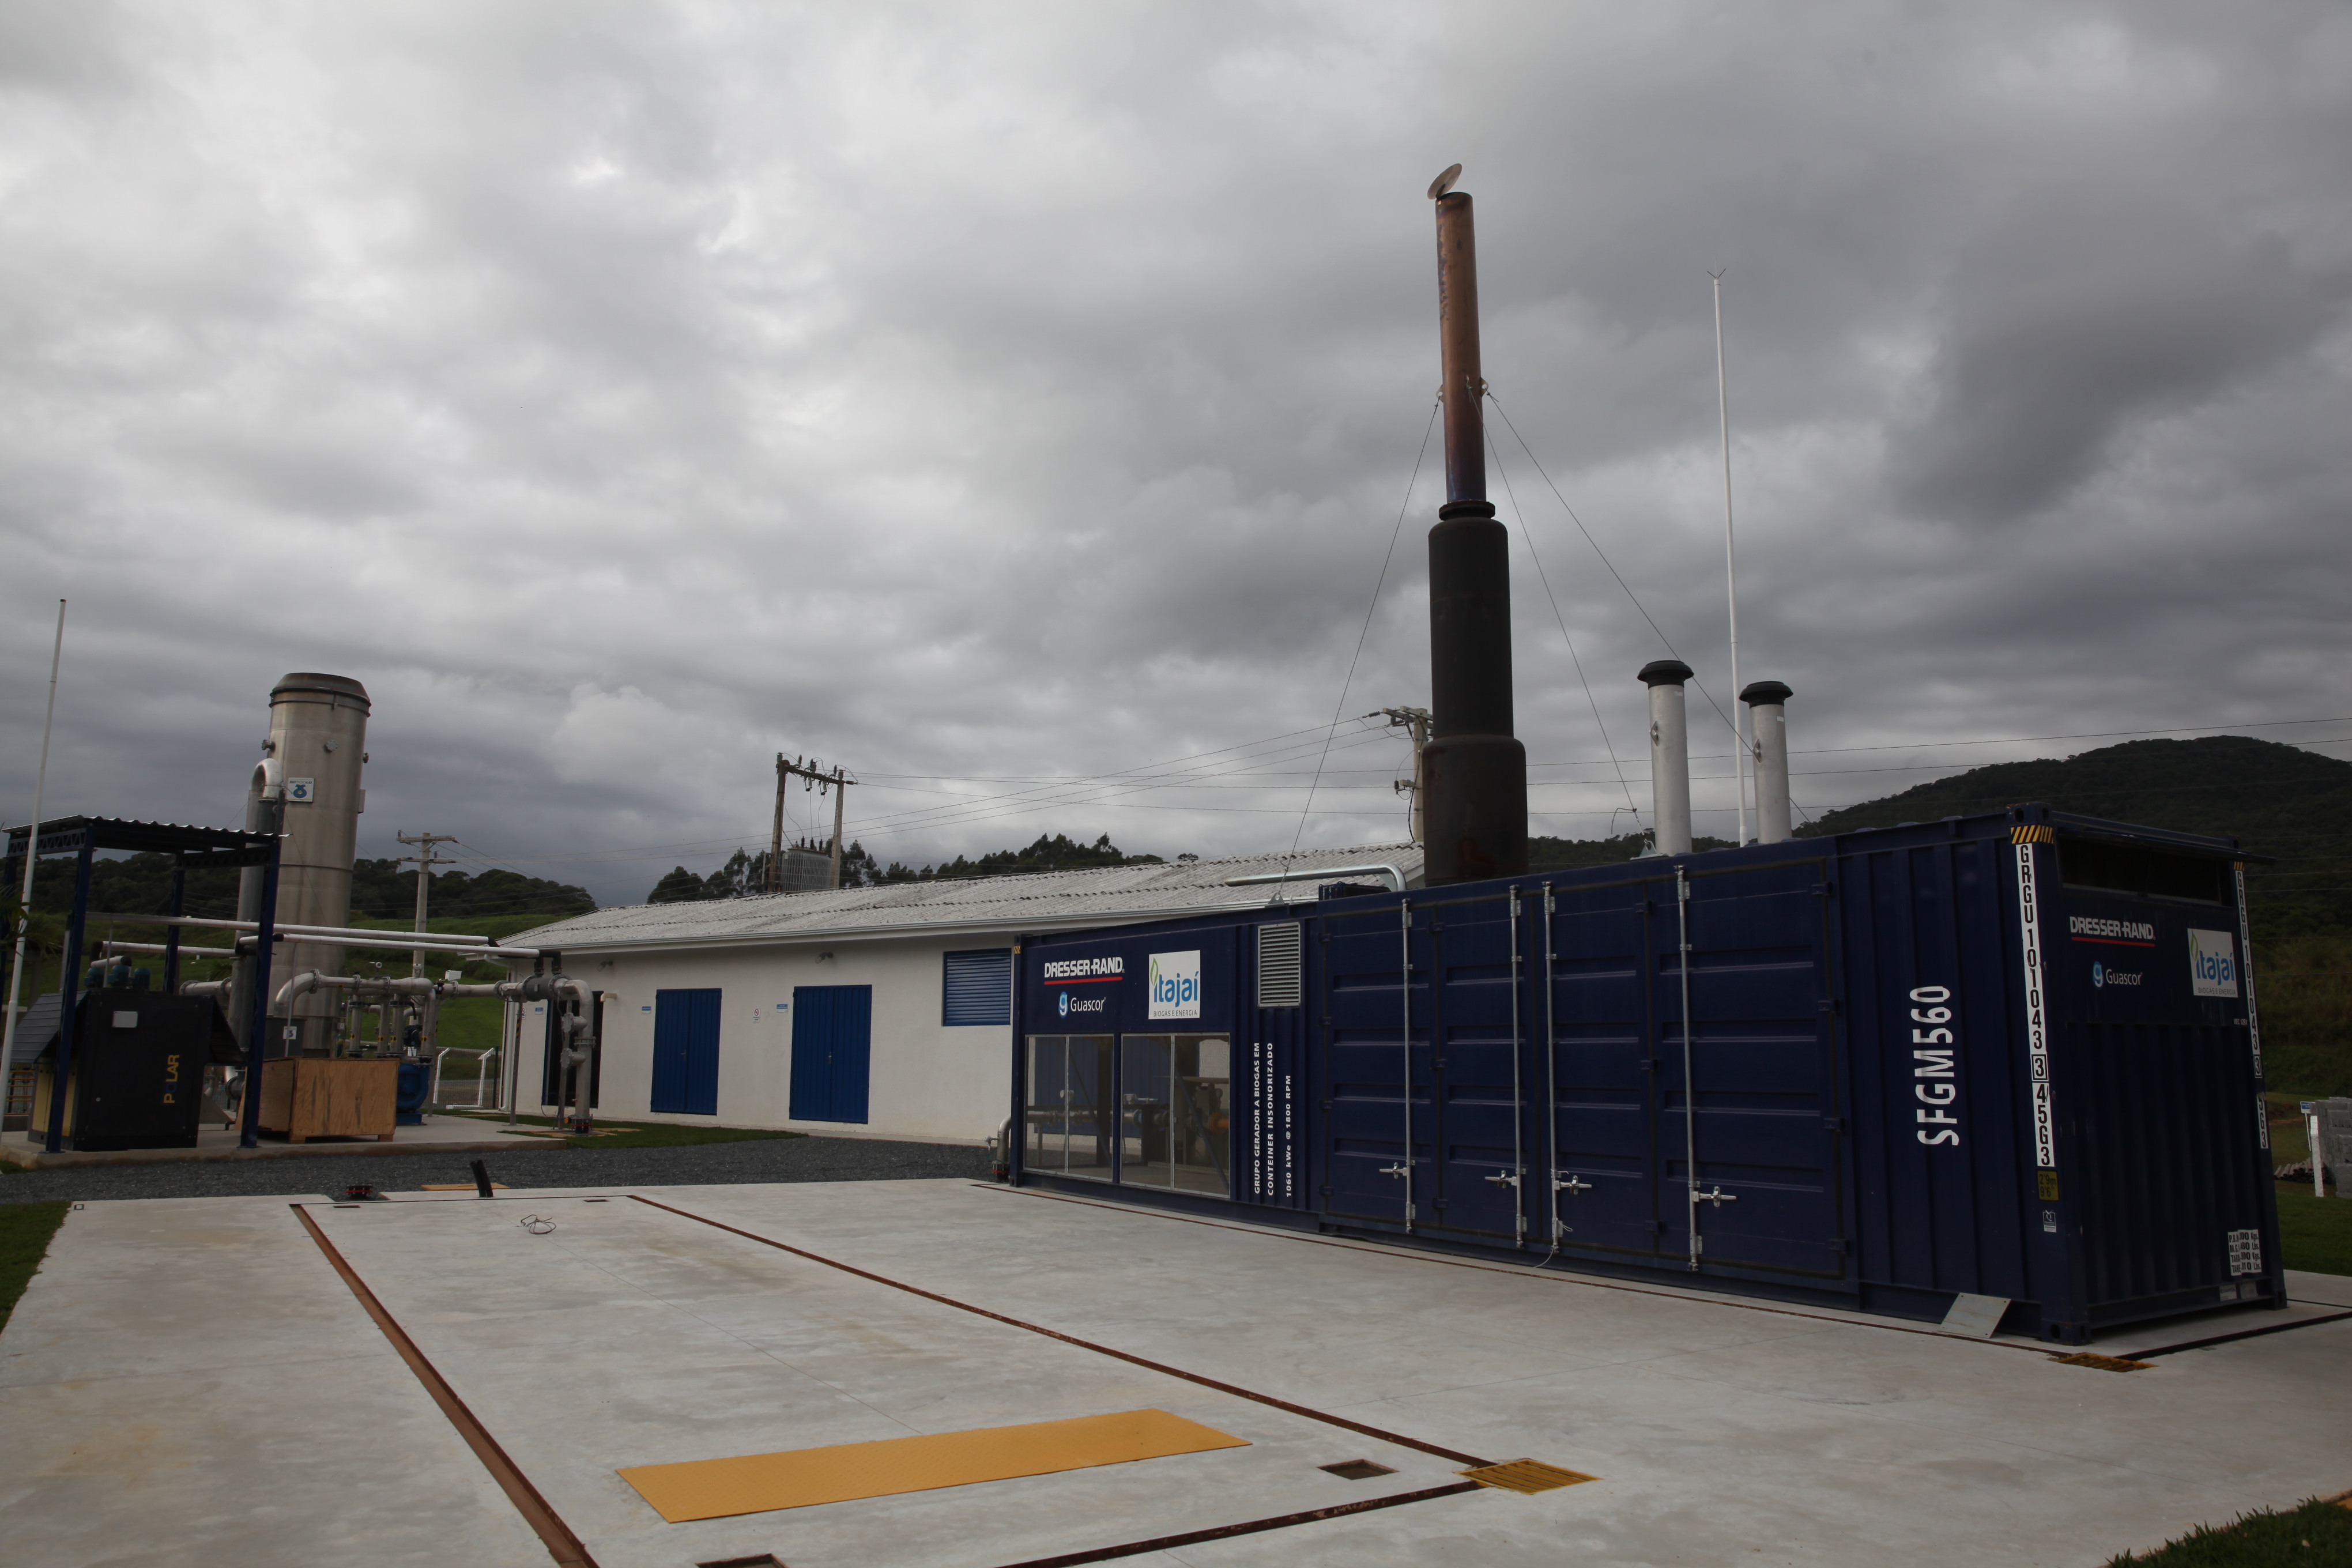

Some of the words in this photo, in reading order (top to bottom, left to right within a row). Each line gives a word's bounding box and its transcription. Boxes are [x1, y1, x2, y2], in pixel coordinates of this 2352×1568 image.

[2020, 845, 2034, 924] GRGU
[2237, 871, 2247, 940] GRGU
[2070, 916, 2154, 940] DRESSER-RAND
[1044, 956, 1124, 978] DRESSER-RAND
[2106, 968, 2142, 985] Guascor
[2027, 929, 2042, 1050] 101043
[1070, 997, 1105, 1012] Guascor
[1254, 1042, 1260, 1057] EM
[1909, 986, 1959, 1146] SFGM560
[2034, 1057, 2044, 1077] 3
[2255, 1057, 2261, 1075] 3
[163, 1054, 180, 1103] POLAR
[1286, 1131, 1291, 1140] @
[2036, 1083, 2050, 1166] 45G3
